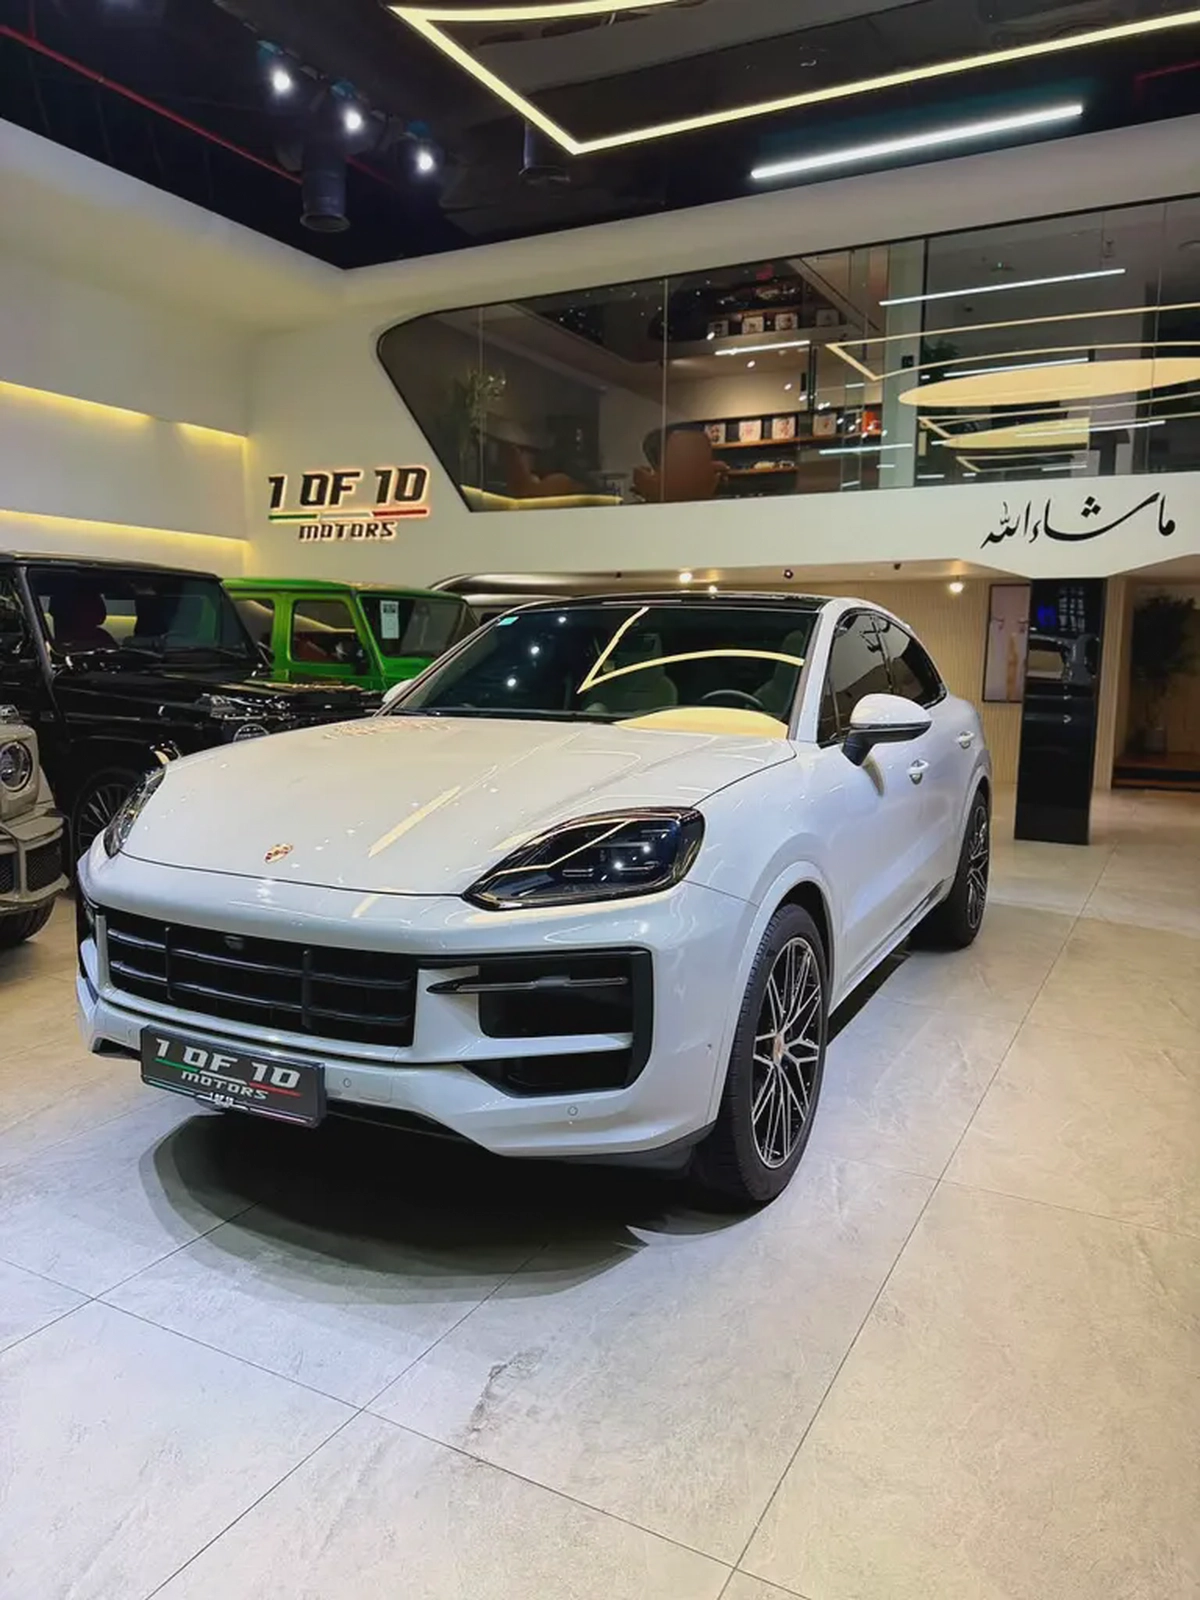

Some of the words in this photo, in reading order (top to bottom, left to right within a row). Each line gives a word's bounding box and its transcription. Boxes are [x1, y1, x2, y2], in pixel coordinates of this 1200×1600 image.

[268, 475, 286, 509] 1
[299, 470, 361, 507] OF
[374, 466, 428, 505] 10
[298, 521, 397, 541] MOTORS
[156, 1037, 171, 1058] 1
[182, 1046, 238, 1072] OF
[251, 1061, 301, 1089] 10
[180, 1070, 270, 1100] MOTORS
